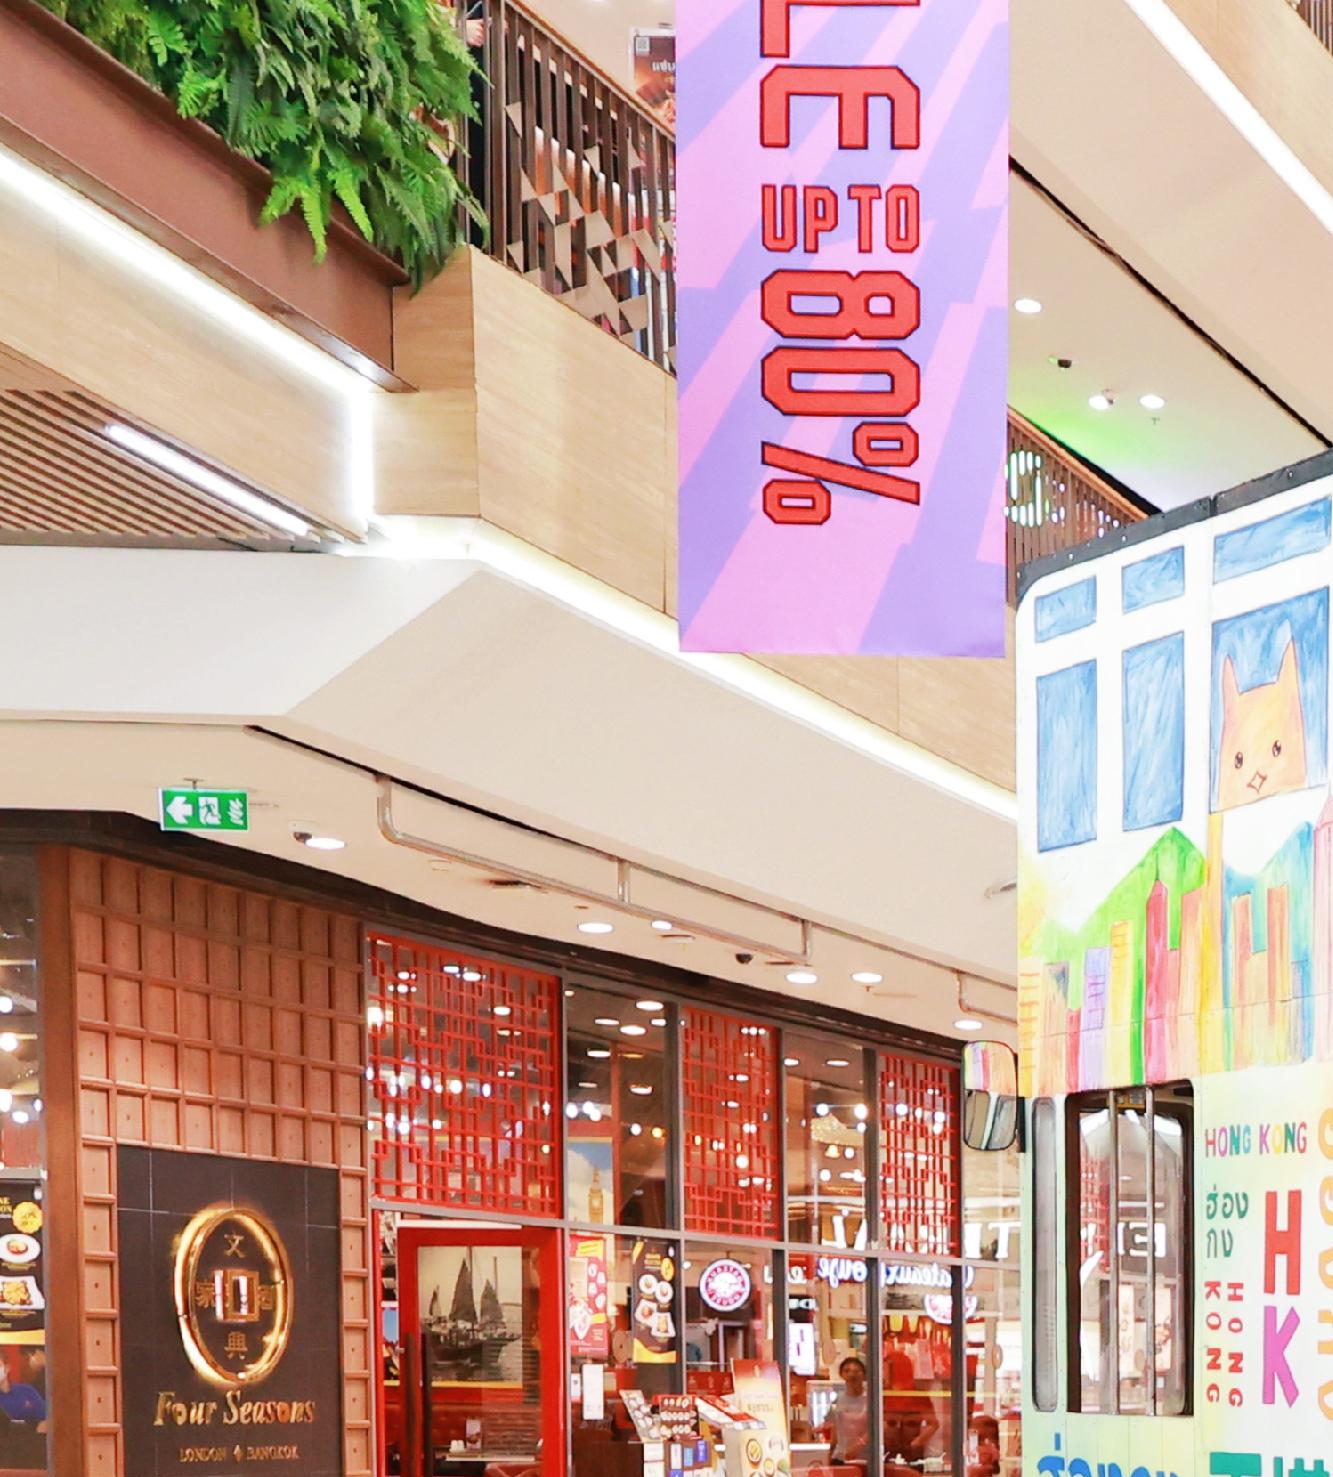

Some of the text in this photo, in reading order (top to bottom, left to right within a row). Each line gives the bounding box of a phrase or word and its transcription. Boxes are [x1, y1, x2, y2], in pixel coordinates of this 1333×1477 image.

[762, 183, 921, 253] UP TO
[760, 269, 921, 526] 80%
[1205, 1122, 1307, 1158] HONG KONG
[1206, 1184, 1249, 1219] ฮ่อง
[1207, 1228, 1233, 1258] กง
[1204, 1281, 1222, 1402] KONG
[1227, 1282, 1244, 1407] HONG
[153, 1390, 315, 1426] Four Seasons
[180, 1445, 299, 1463] LONDON BANGKOK
